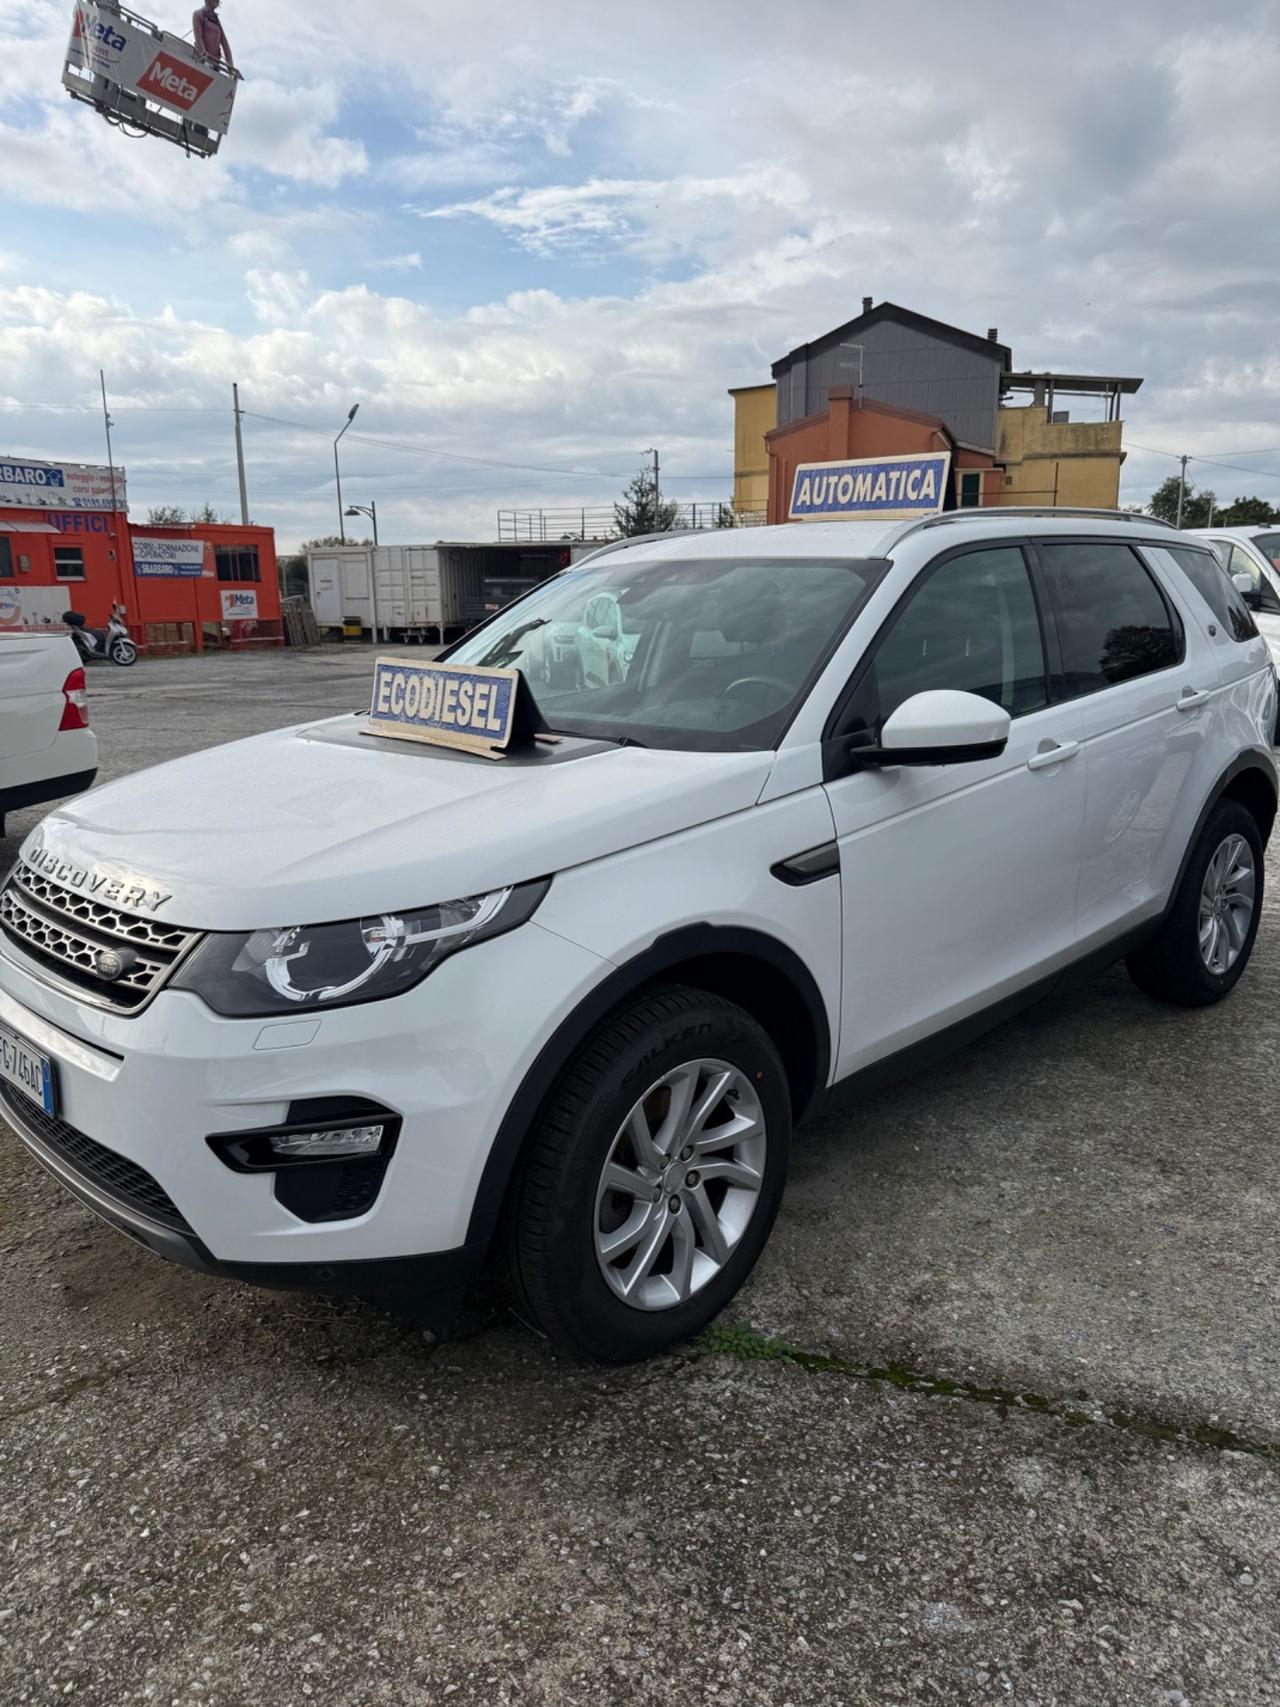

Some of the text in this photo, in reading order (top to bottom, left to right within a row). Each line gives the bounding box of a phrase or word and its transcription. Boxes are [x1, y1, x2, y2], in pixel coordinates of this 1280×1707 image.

[149, 62, 198, 101] Meta
[797, 467, 936, 506] AUTOMATICA
[48, 512, 108, 532] UFFICI
[235, 593, 254, 604] Meta
[377, 671, 502, 731] ECODIESEL
[29, 847, 173, 912] DISCOVERY
